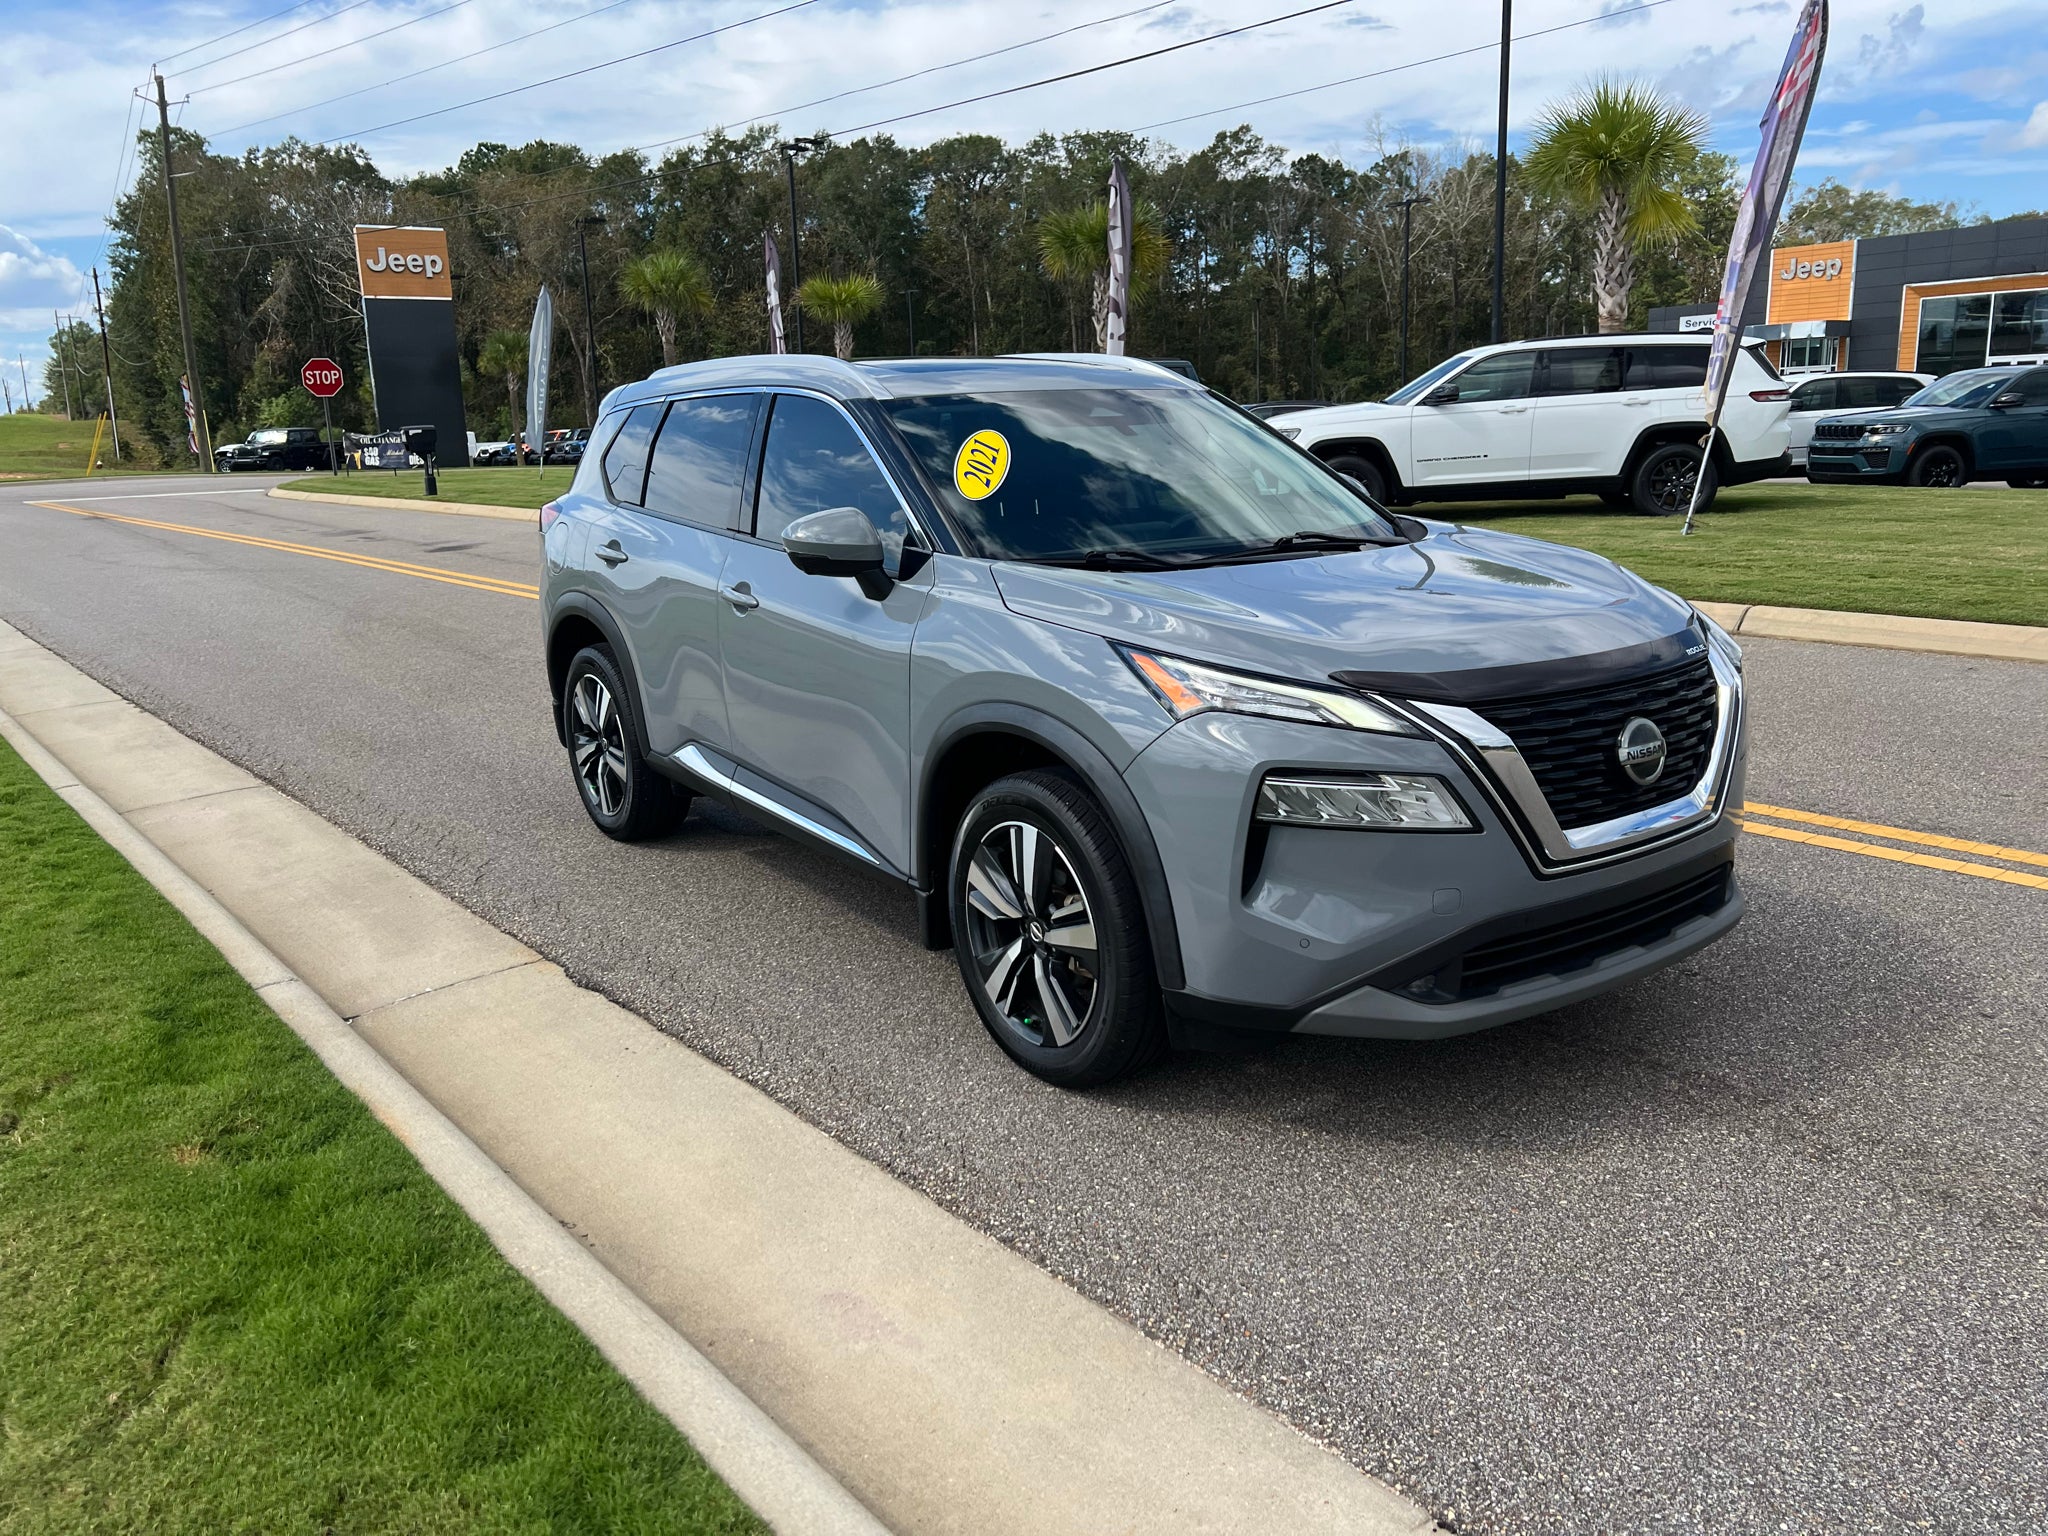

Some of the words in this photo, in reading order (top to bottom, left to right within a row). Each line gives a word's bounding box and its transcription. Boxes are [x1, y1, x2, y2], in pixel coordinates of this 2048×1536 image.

[366, 246, 443, 279] Jeep
[1780, 257, 1843, 281] Jeep
[1685, 318, 1717, 328] Servic
[305, 370, 340, 385] STOP
[365, 456, 380, 466] GAS
[408, 454, 425, 466] DIES
[964, 439, 1000, 489] 2021
[1626, 744, 1663, 760] NISSAN
